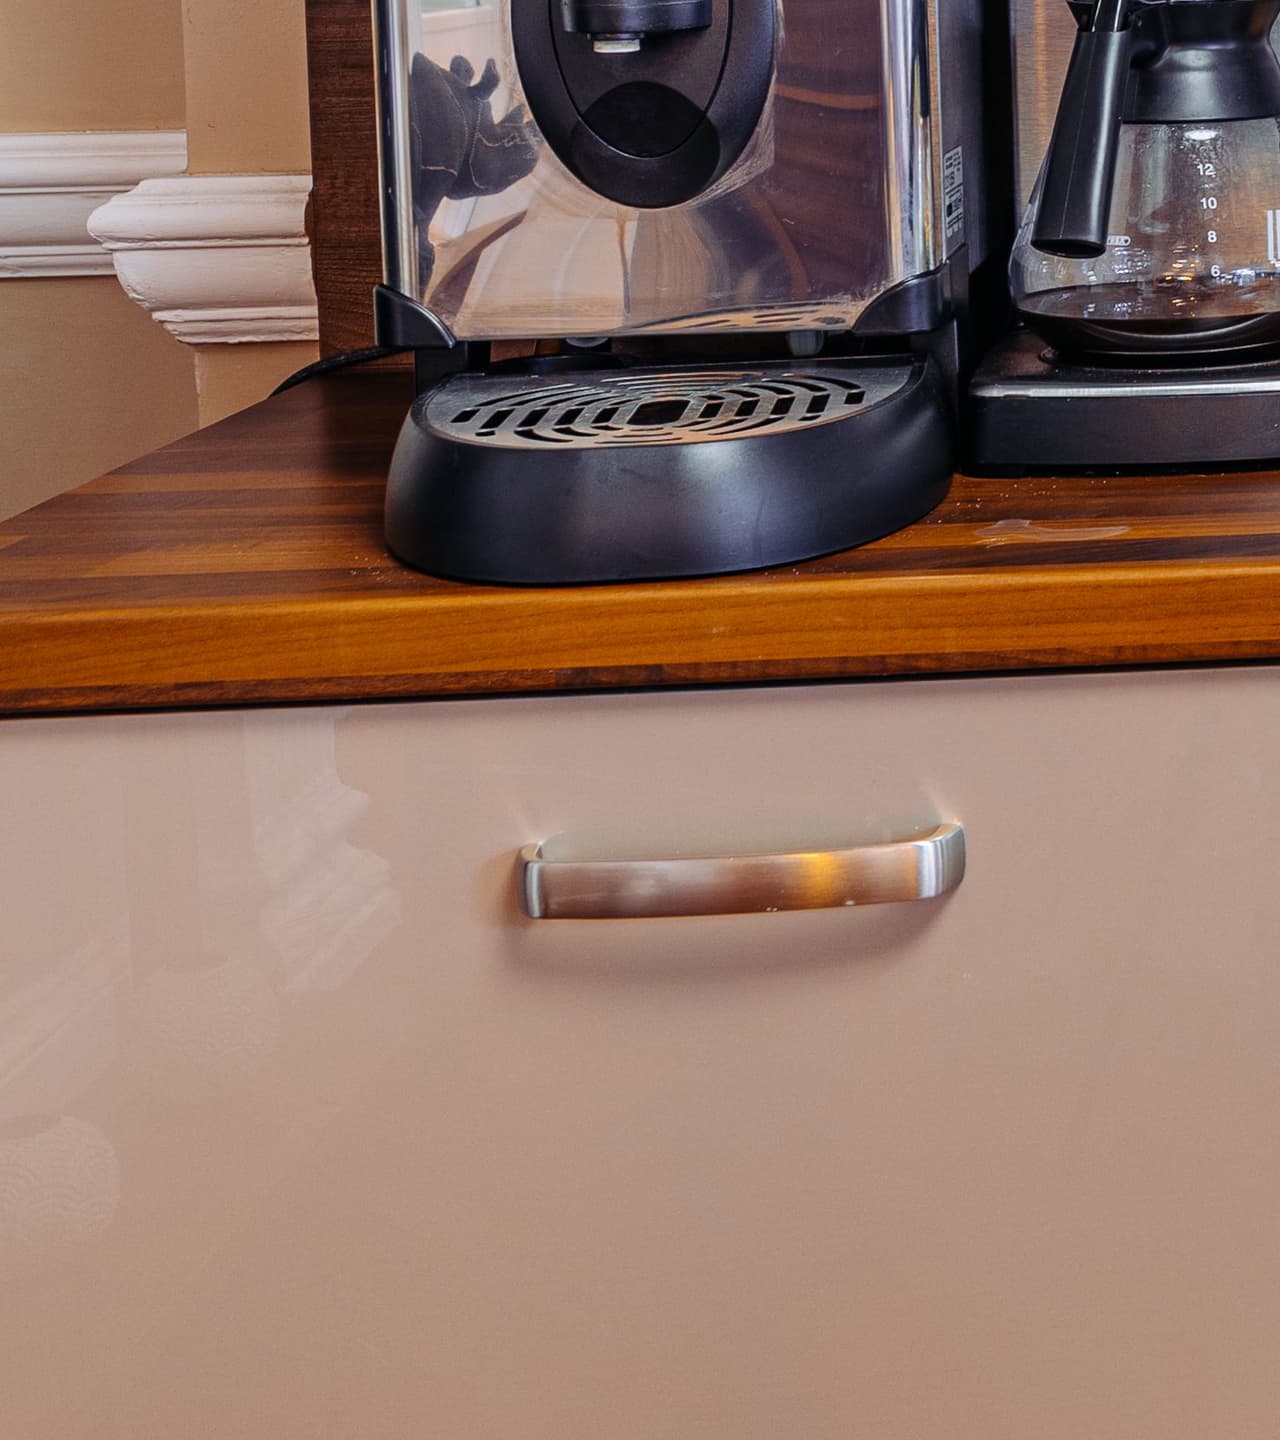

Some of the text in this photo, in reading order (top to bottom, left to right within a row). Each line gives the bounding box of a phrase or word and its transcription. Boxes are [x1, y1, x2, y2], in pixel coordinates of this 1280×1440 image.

[1197, 164, 1216, 176] 12
[1200, 197, 1217, 209] 10
[1207, 230, 1217, 242] 8
[1210, 264, 1220, 277] 6
